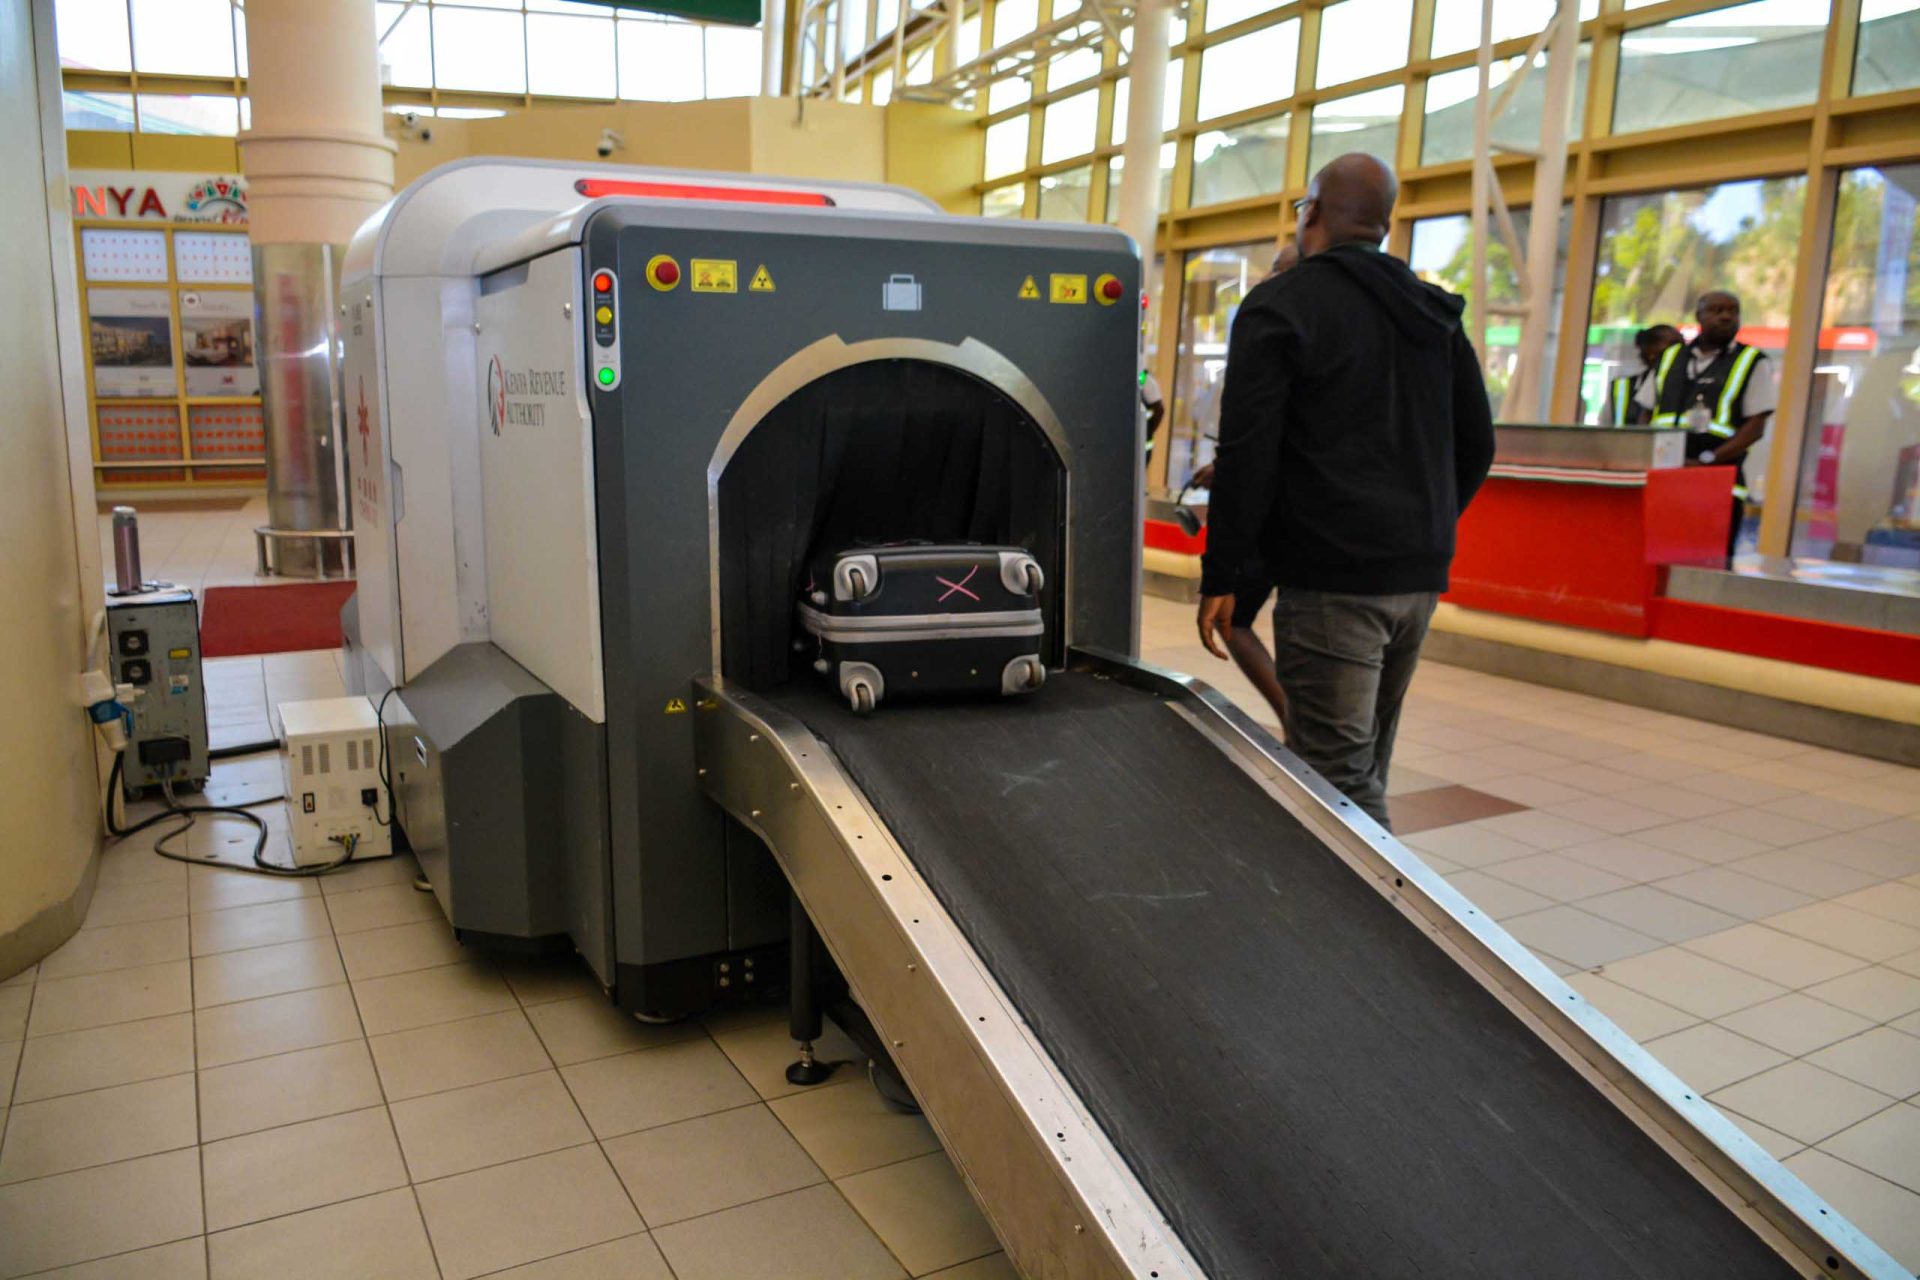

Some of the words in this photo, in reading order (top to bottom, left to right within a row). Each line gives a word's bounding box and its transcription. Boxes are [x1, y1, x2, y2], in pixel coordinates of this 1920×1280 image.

[71, 185, 167, 218] NYA
[505, 369, 528, 396] KENYA
[529, 368, 567, 397] REVENUE
[506, 400, 546, 428] AUTHORITY
